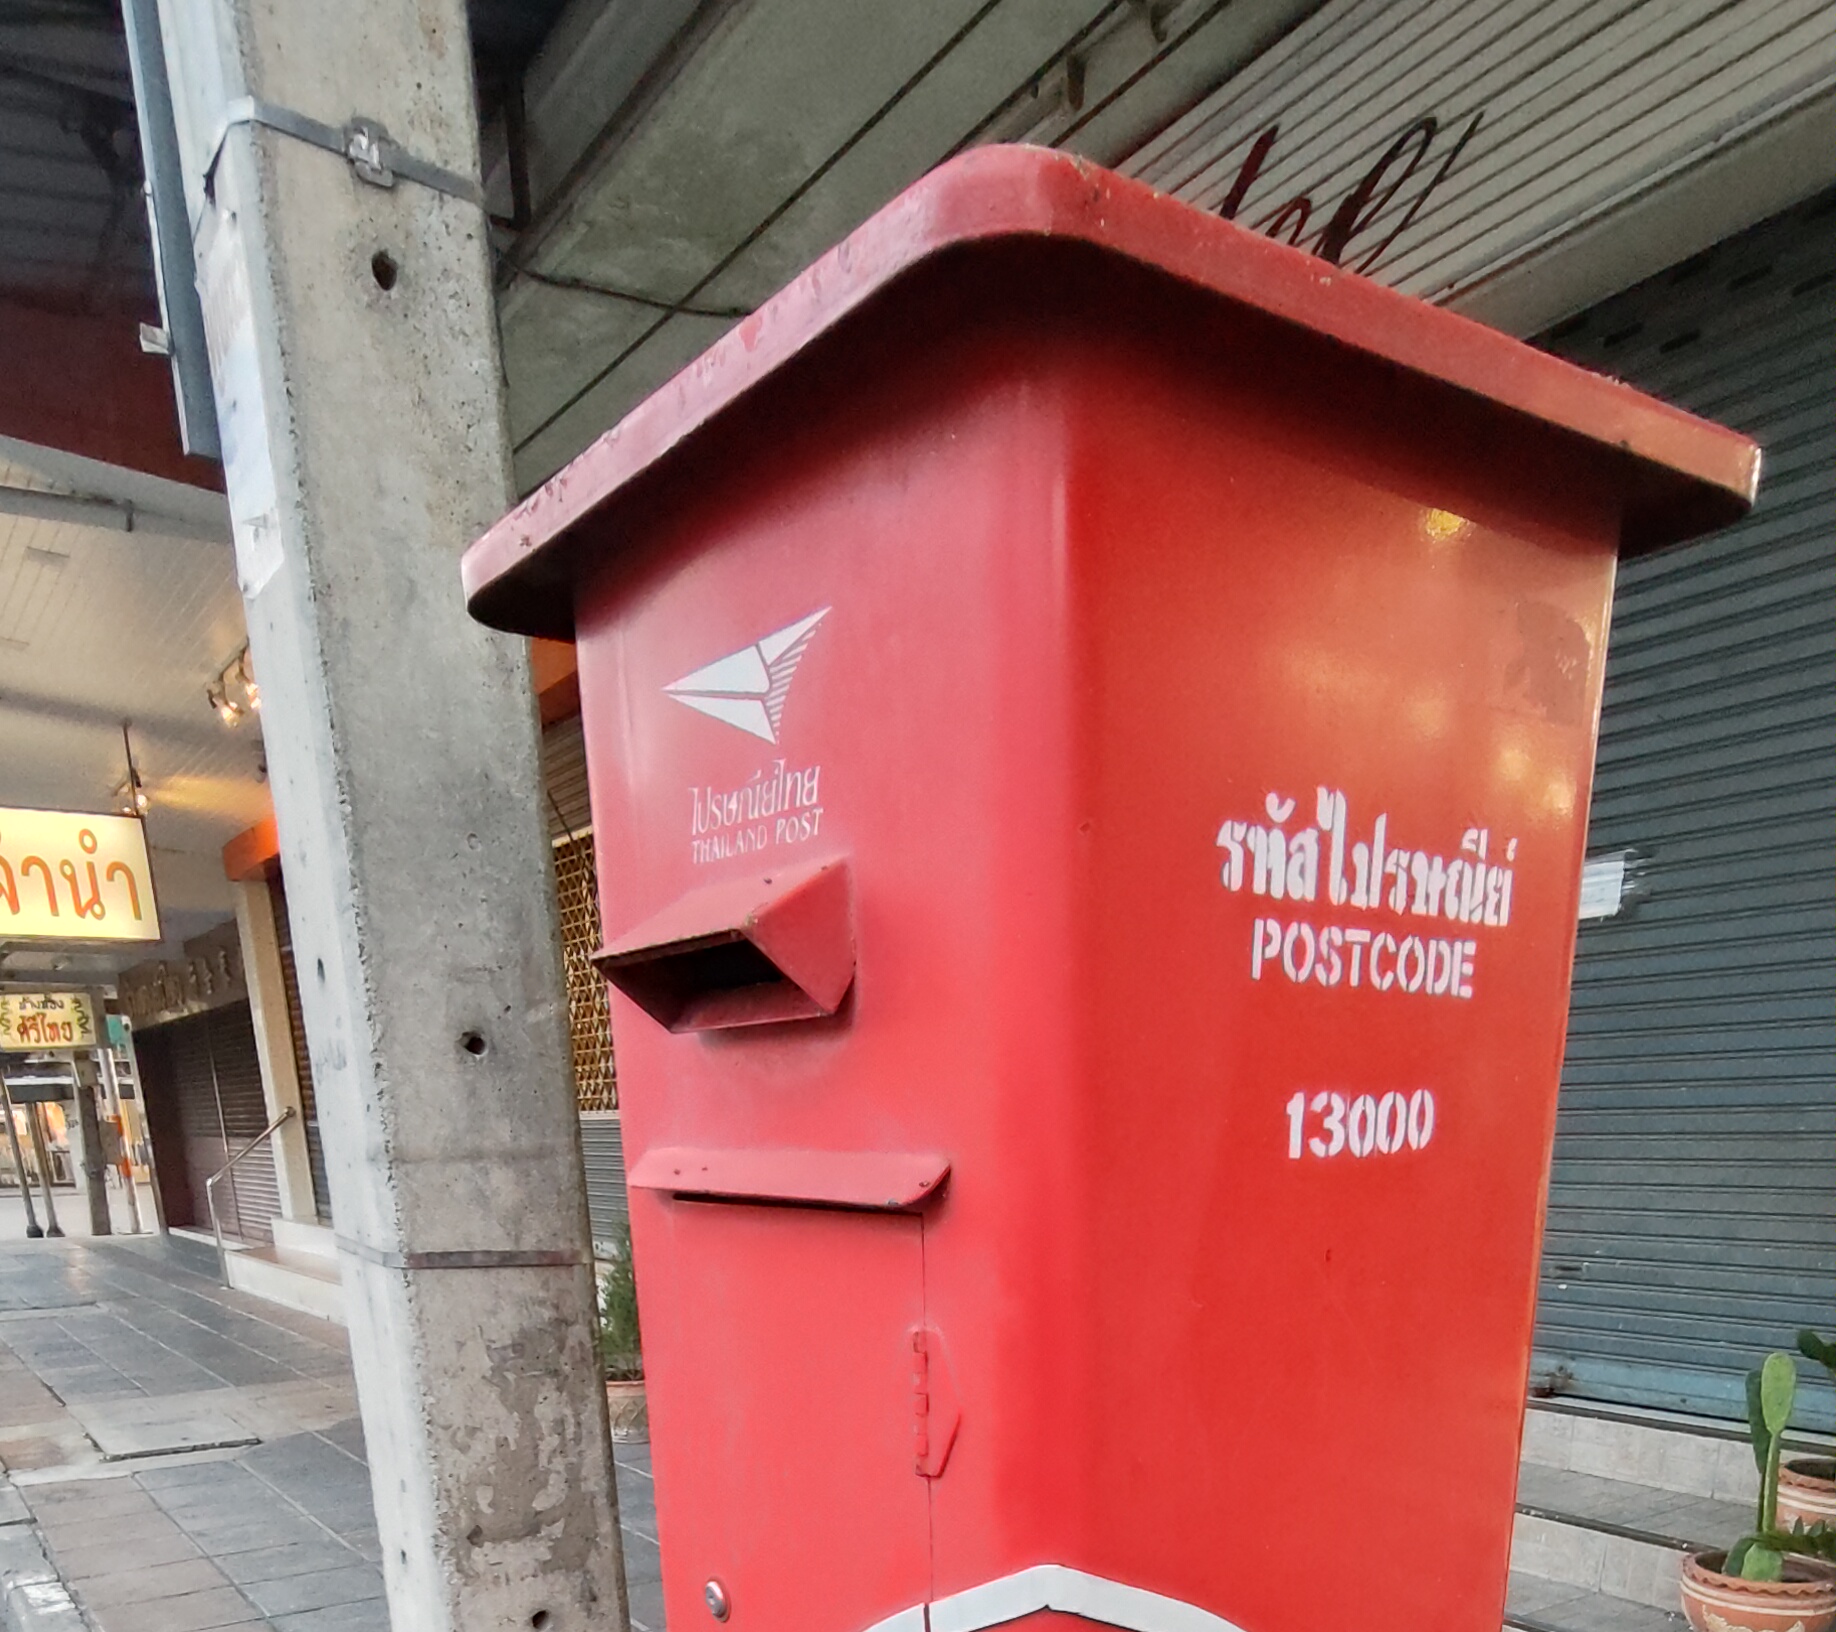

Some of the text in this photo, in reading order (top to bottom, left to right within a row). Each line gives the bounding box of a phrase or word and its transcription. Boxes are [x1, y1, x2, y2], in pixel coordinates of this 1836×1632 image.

[688, 758, 822, 835] ไปรษณีย์ไทย
[693, 808, 824, 864] THAILAND POST
[1216, 785, 1518, 927] รหัสไปรษณีย์
[1250, 918, 1476, 998] POSTCODE
[1286, 1089, 1434, 1160] 13000
